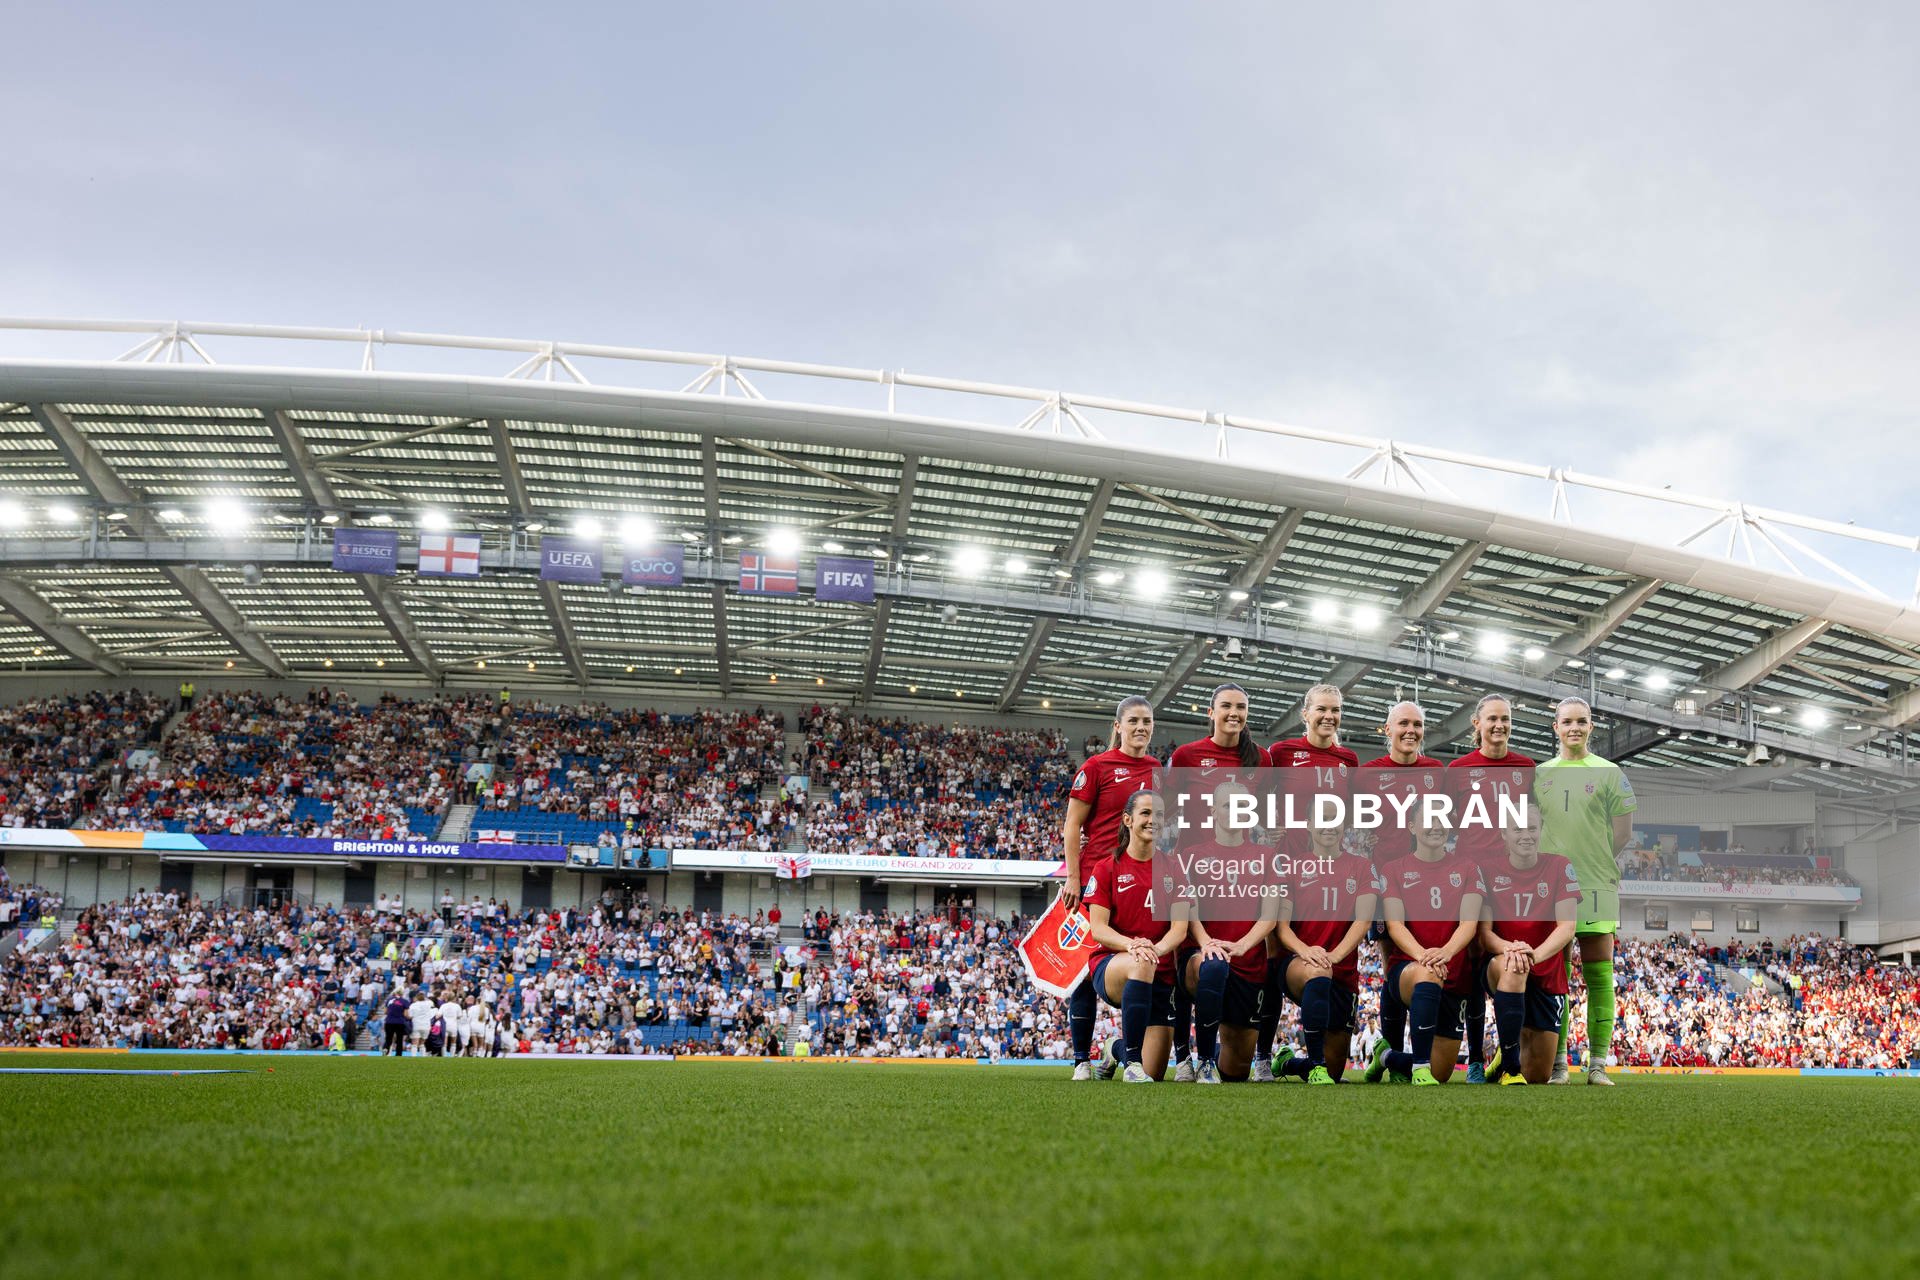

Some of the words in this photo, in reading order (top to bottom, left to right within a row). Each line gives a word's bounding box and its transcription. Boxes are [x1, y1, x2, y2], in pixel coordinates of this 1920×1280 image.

[352, 547, 391, 557] RESPECT
[549, 552, 593, 566] UEFA
[1314, 766, 1335, 789] 14
[1490, 780, 1511, 803] 10
[1564, 789, 1570, 813] 1
[333, 841, 404, 854] BRIGHTON
[408, 843, 417, 854] &
[421, 844, 460, 856] HOVE
[855, 858, 888, 868] EURO
[891, 859, 945, 870] ENGLAND
[948, 861, 974, 871] 2022
[1144, 889, 1156, 914] 4
[1322, 887, 1338, 911] 11
[1430, 886, 1442, 910] 8
[1674, 886, 1700, 894] EURO
[1513, 893, 1534, 917] 17
[1591, 891, 1598, 913] 1
